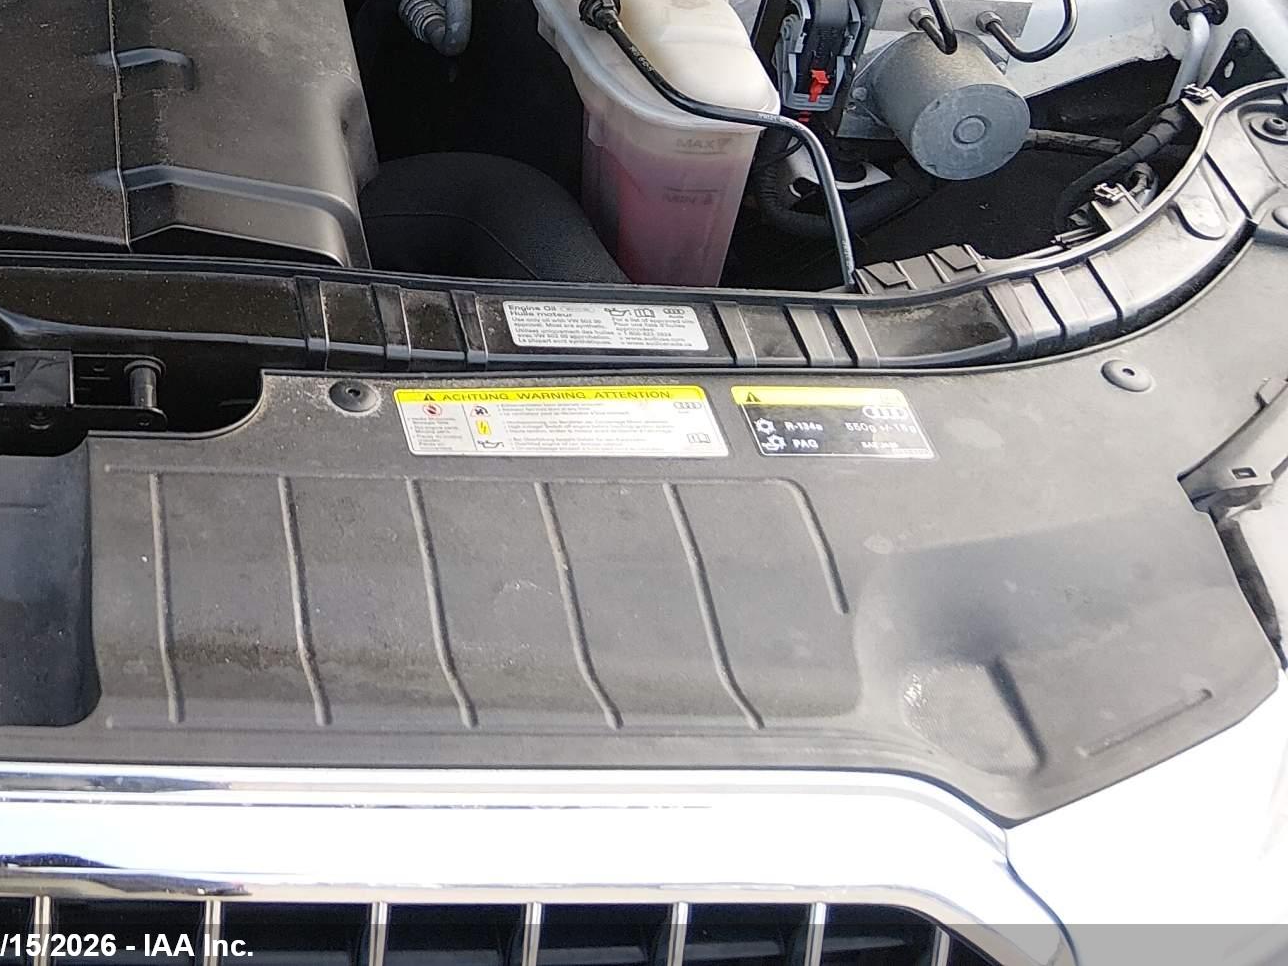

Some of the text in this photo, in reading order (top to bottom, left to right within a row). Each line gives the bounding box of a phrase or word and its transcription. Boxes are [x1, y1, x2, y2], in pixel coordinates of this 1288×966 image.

[675, 138, 714, 149] MAX
[508, 304, 541, 313] Engine
[442, 390, 671, 401] ACHTUNG WARNING ATTENTION
[783, 420, 824, 431] R-134a
[791, 438, 819, 449] PAG
